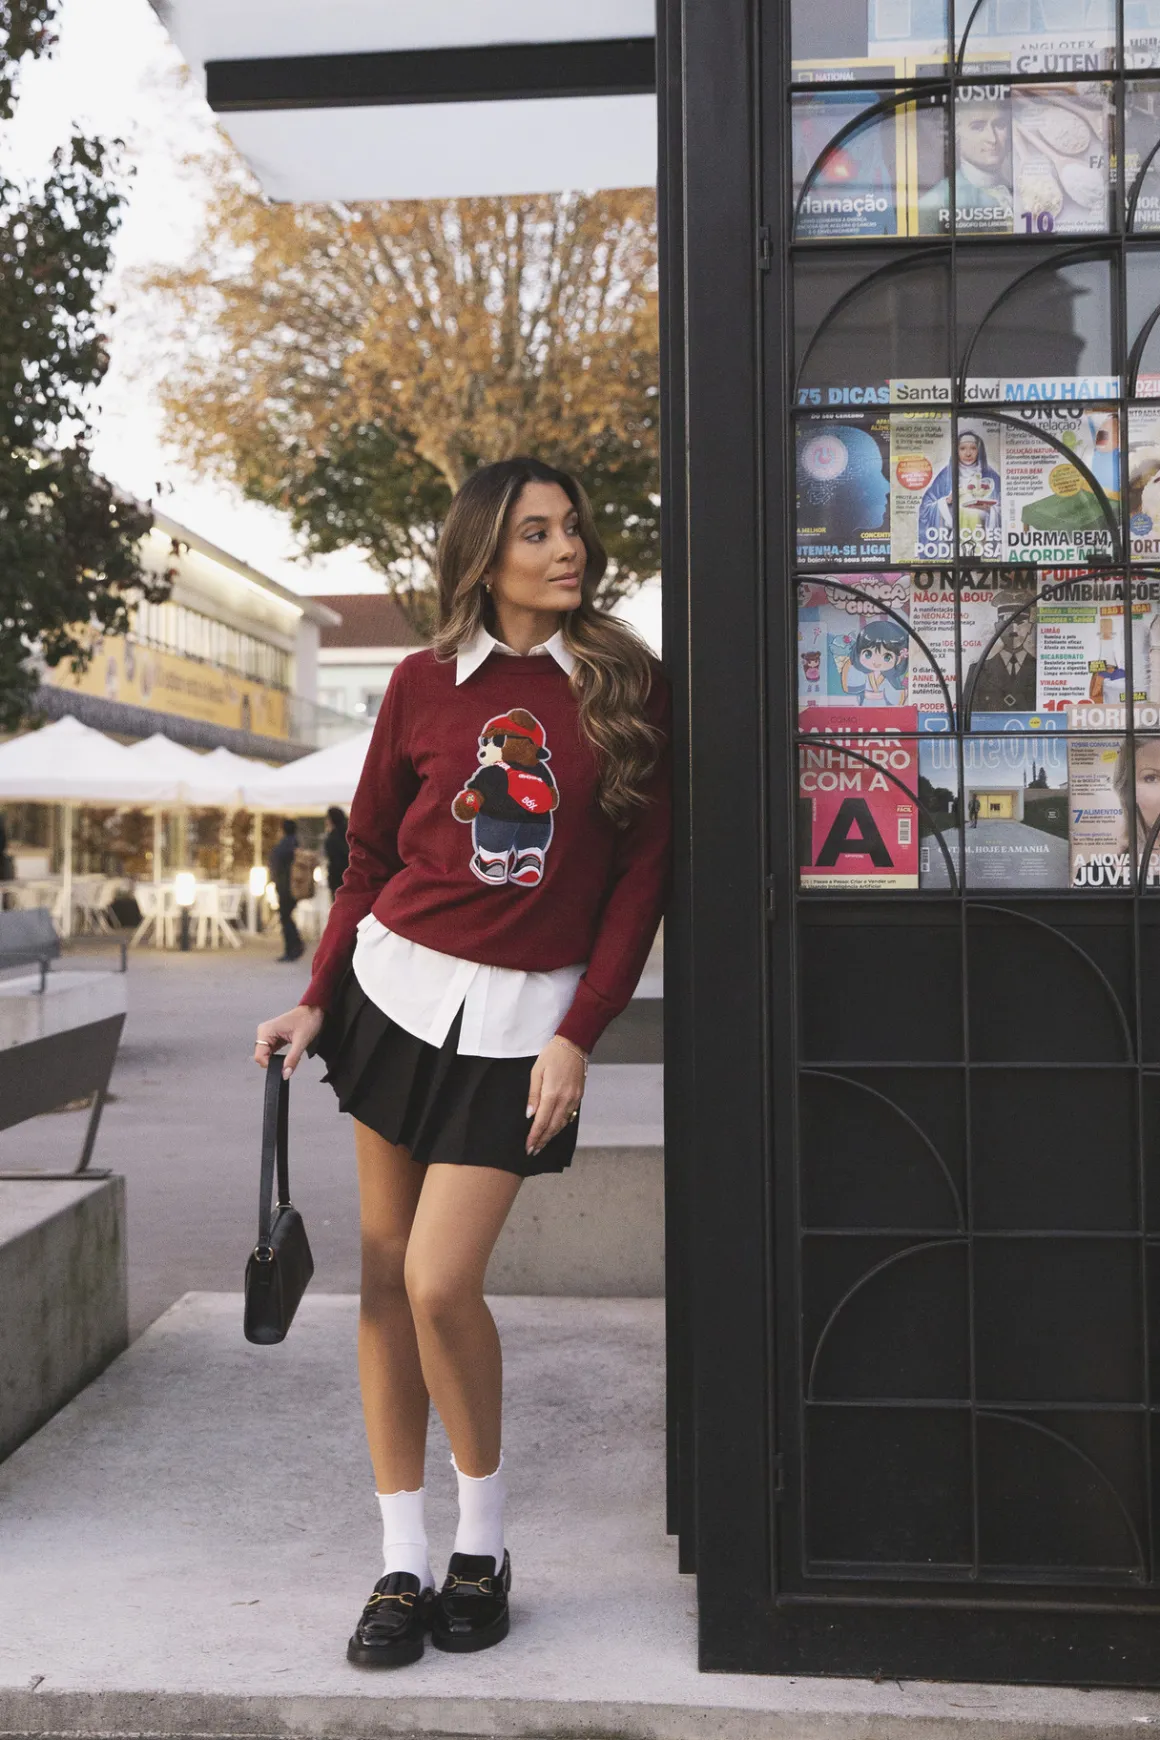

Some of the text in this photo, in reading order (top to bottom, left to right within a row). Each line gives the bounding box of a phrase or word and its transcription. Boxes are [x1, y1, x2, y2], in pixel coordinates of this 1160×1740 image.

[815, 72, 855, 81] NATIONAL
[1021, 211, 1054, 233] 10
[799, 386, 890, 405] 75 DICAS
[896, 383, 1000, 400] Santa dwi
[1006, 383, 1056, 400] MAU
[1039, 420, 1081, 432] relação?
[1008, 531, 1111, 548] DURMA BEM,
[1008, 549, 1076, 562] ACORDE
[914, 571, 935, 590] O
[914, 591, 938, 602] NÃO
[941, 640, 982, 648] IDEOGIA
[831, 716, 858, 724] COMO
[799, 727, 903, 747] ANHAR
[800, 772, 889, 792] COM A
[1072, 809, 1083, 824] 7
[975, 845, 1000, 853] HOJE
[1008, 844, 1050, 853] AMANHÃ
[1075, 853, 1086, 866] A
